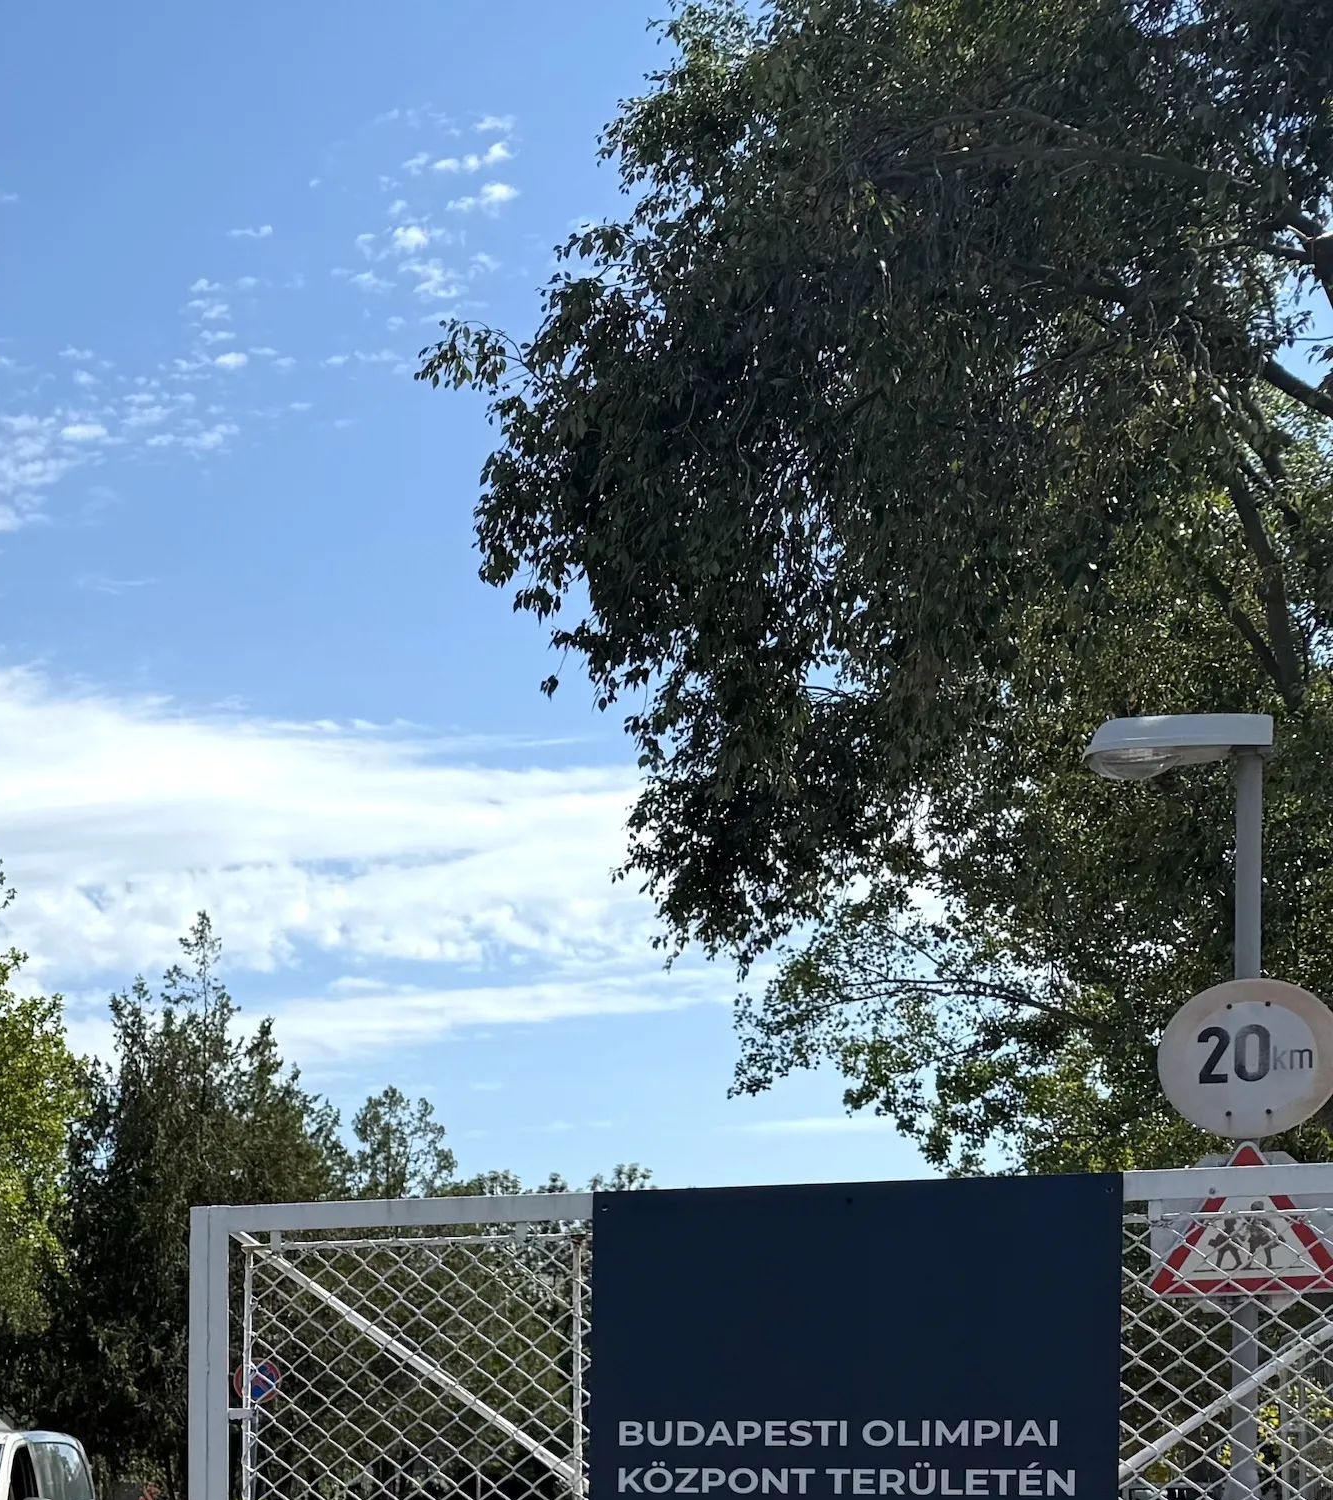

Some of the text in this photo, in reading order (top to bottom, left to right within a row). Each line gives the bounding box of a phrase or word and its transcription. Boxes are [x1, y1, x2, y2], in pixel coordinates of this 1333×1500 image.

[617, 1419, 1059, 1447] BUDAPESTI OLIMPIAI
[617, 1460, 1077, 1497] KÖZPONT TERÜLETÉN
